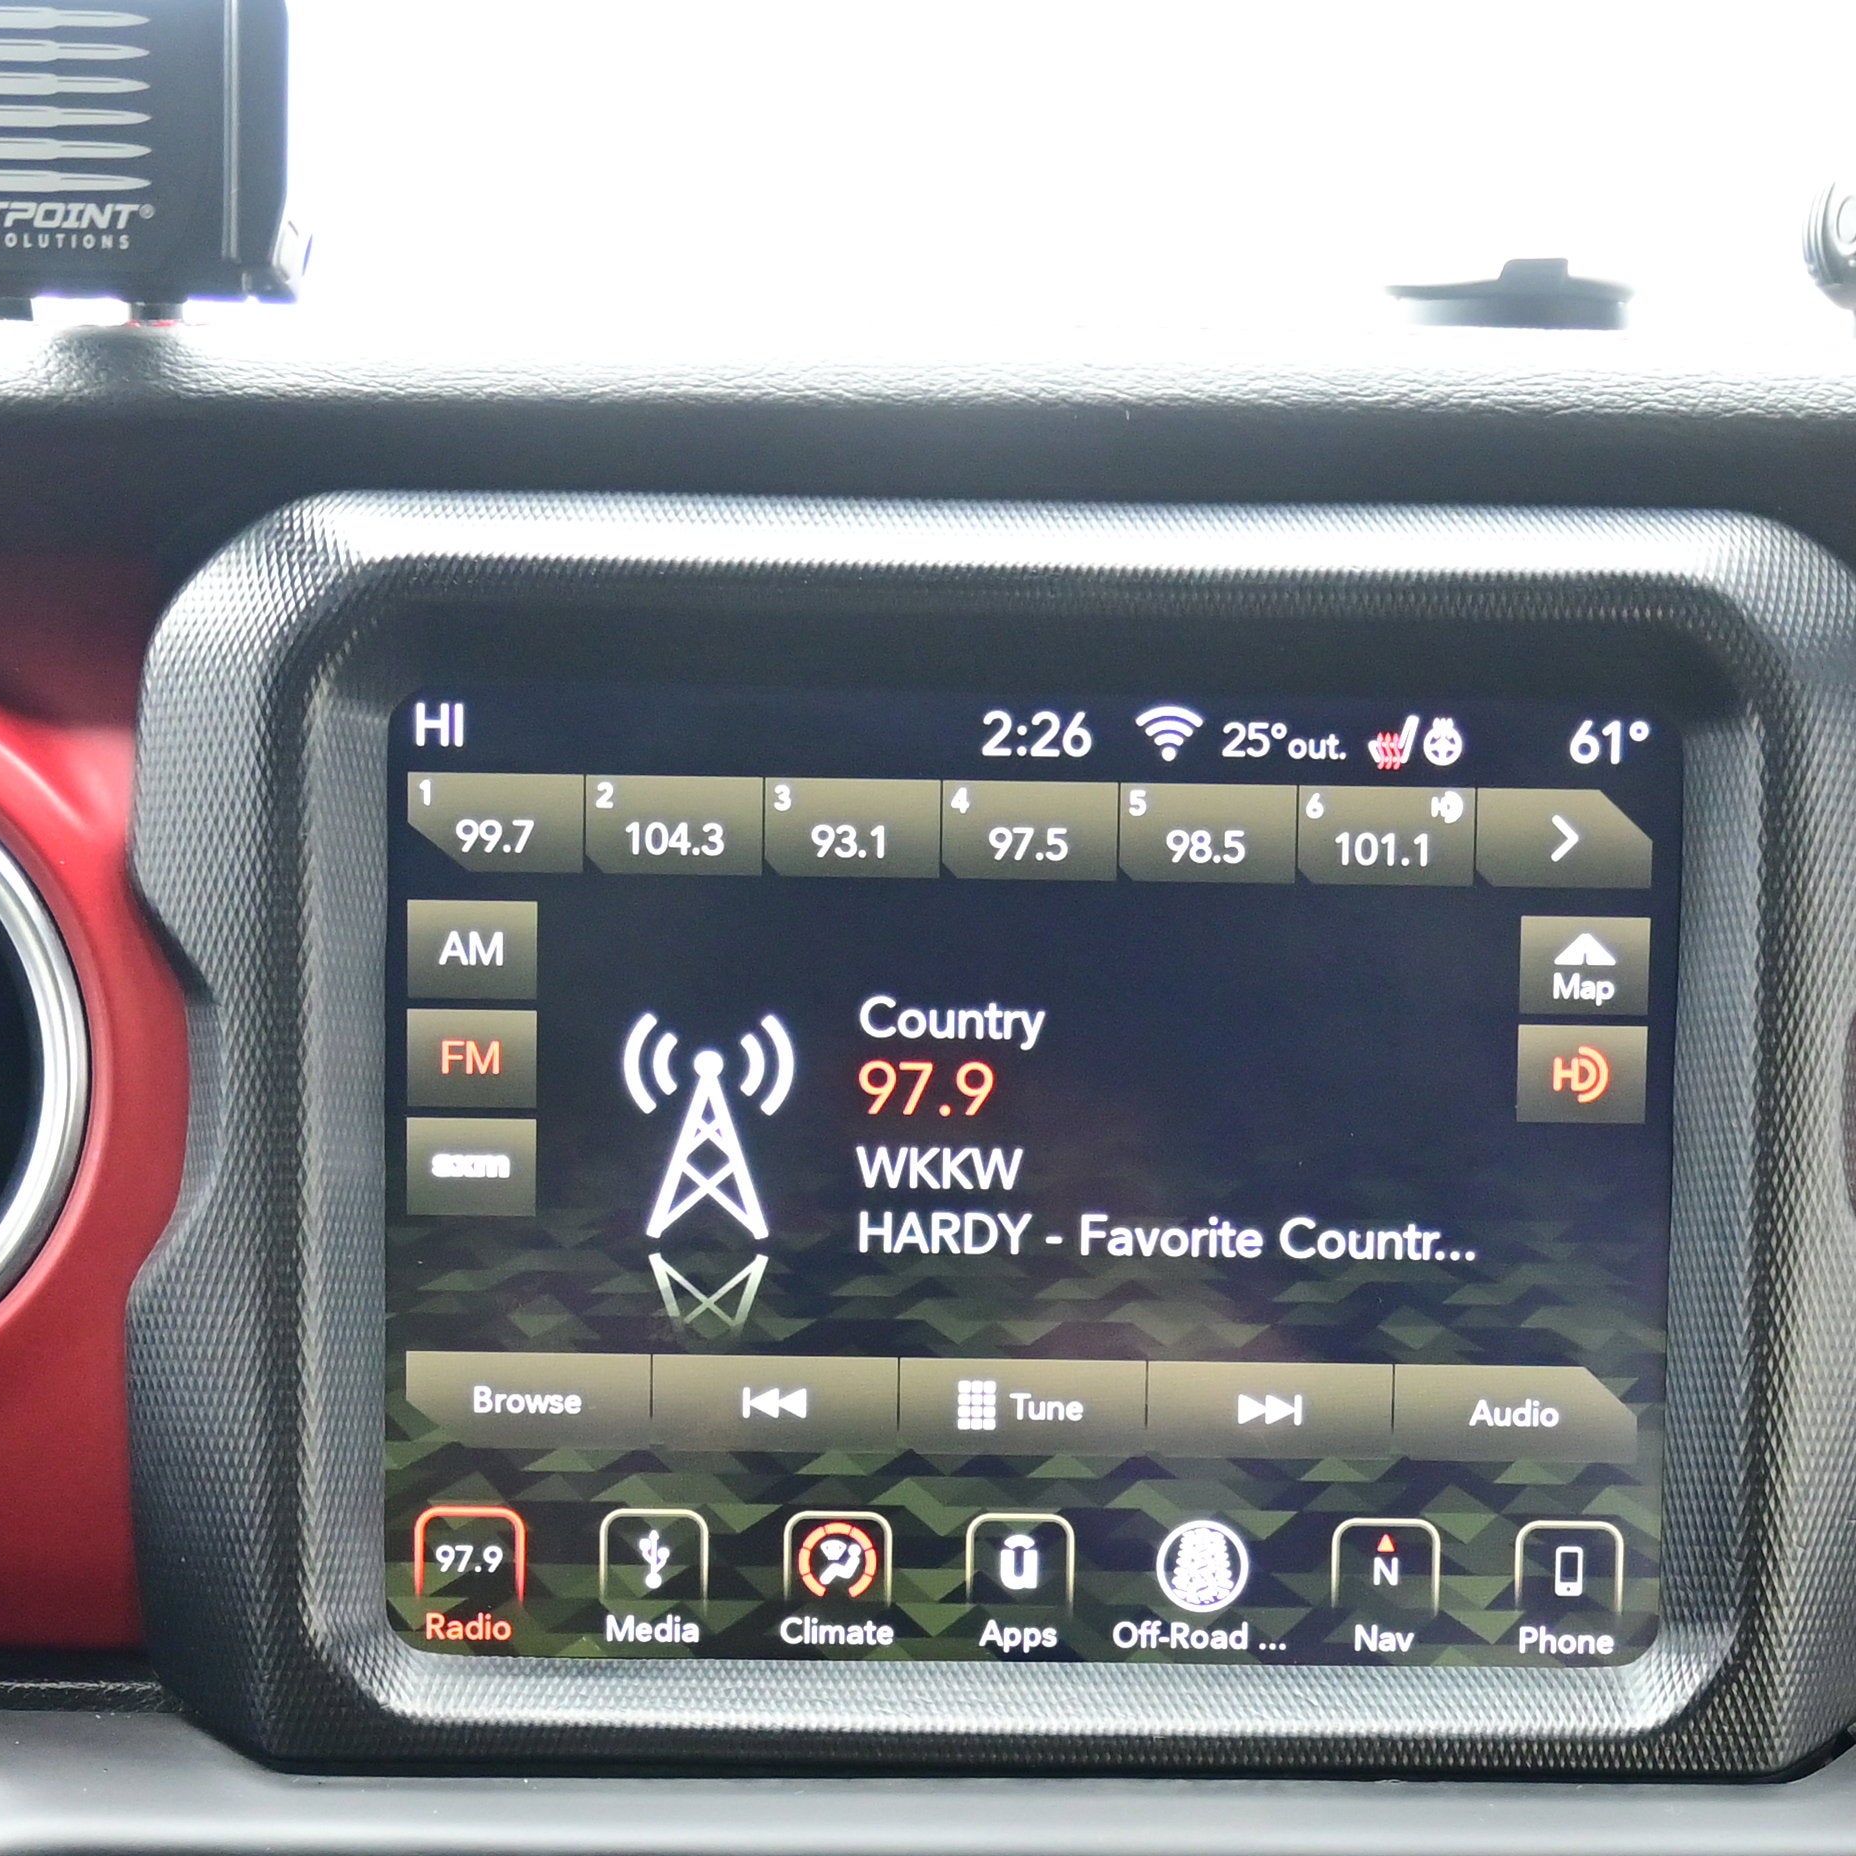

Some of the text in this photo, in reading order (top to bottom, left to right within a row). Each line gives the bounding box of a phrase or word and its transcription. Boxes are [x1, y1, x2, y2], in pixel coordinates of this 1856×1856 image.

[415, 702, 464, 748] HI
[981, 709, 1093, 758] 2:26
[1287, 733, 1348, 761] out.
[1569, 720, 1651, 766] 61°
[419, 779, 432, 806] 1
[595, 782, 614, 809] 2
[774, 785, 792, 811] 3
[950, 787, 970, 814] 4
[1129, 790, 1147, 817] 5
[1305, 792, 1325, 819] 6
[455, 819, 535, 853] 99.7
[625, 822, 725, 856] 104.3
[811, 824, 886, 859] 93.1
[988, 827, 1069, 861] 97.5
[1166, 829, 1246, 864] 98.5
[1334, 831, 1429, 867] 101.1
[438, 930, 504, 966] AM
[1552, 972, 1616, 1006] Map
[858, 995, 1046, 1051] Country
[440, 1038, 501, 1075] FM
[857, 1059, 995, 1117] 97.9
[856, 1146, 1023, 1191] WKKW
[857, 1212, 1031, 1256] HARDY
[1080, 1215, 1263, 1259] Favorite
[1278, 1217, 1477, 1263] Countr...
[472, 1385, 583, 1415] Browse
[1009, 1392, 1084, 1422] Tune
[1469, 1399, 1560, 1429] Audio
[434, 1545, 504, 1575] 97.9
[1373, 1556, 1399, 1587] N
[424, 1612, 513, 1643] Radio
[605, 1614, 700, 1645] Media
[779, 1617, 895, 1648] Climate
[979, 1620, 1058, 1657] Apps
[1111, 1620, 1249, 1652] Off-Road
[1353, 1624, 1415, 1654] Nav
[1517, 1626, 1615, 1656] Phone
